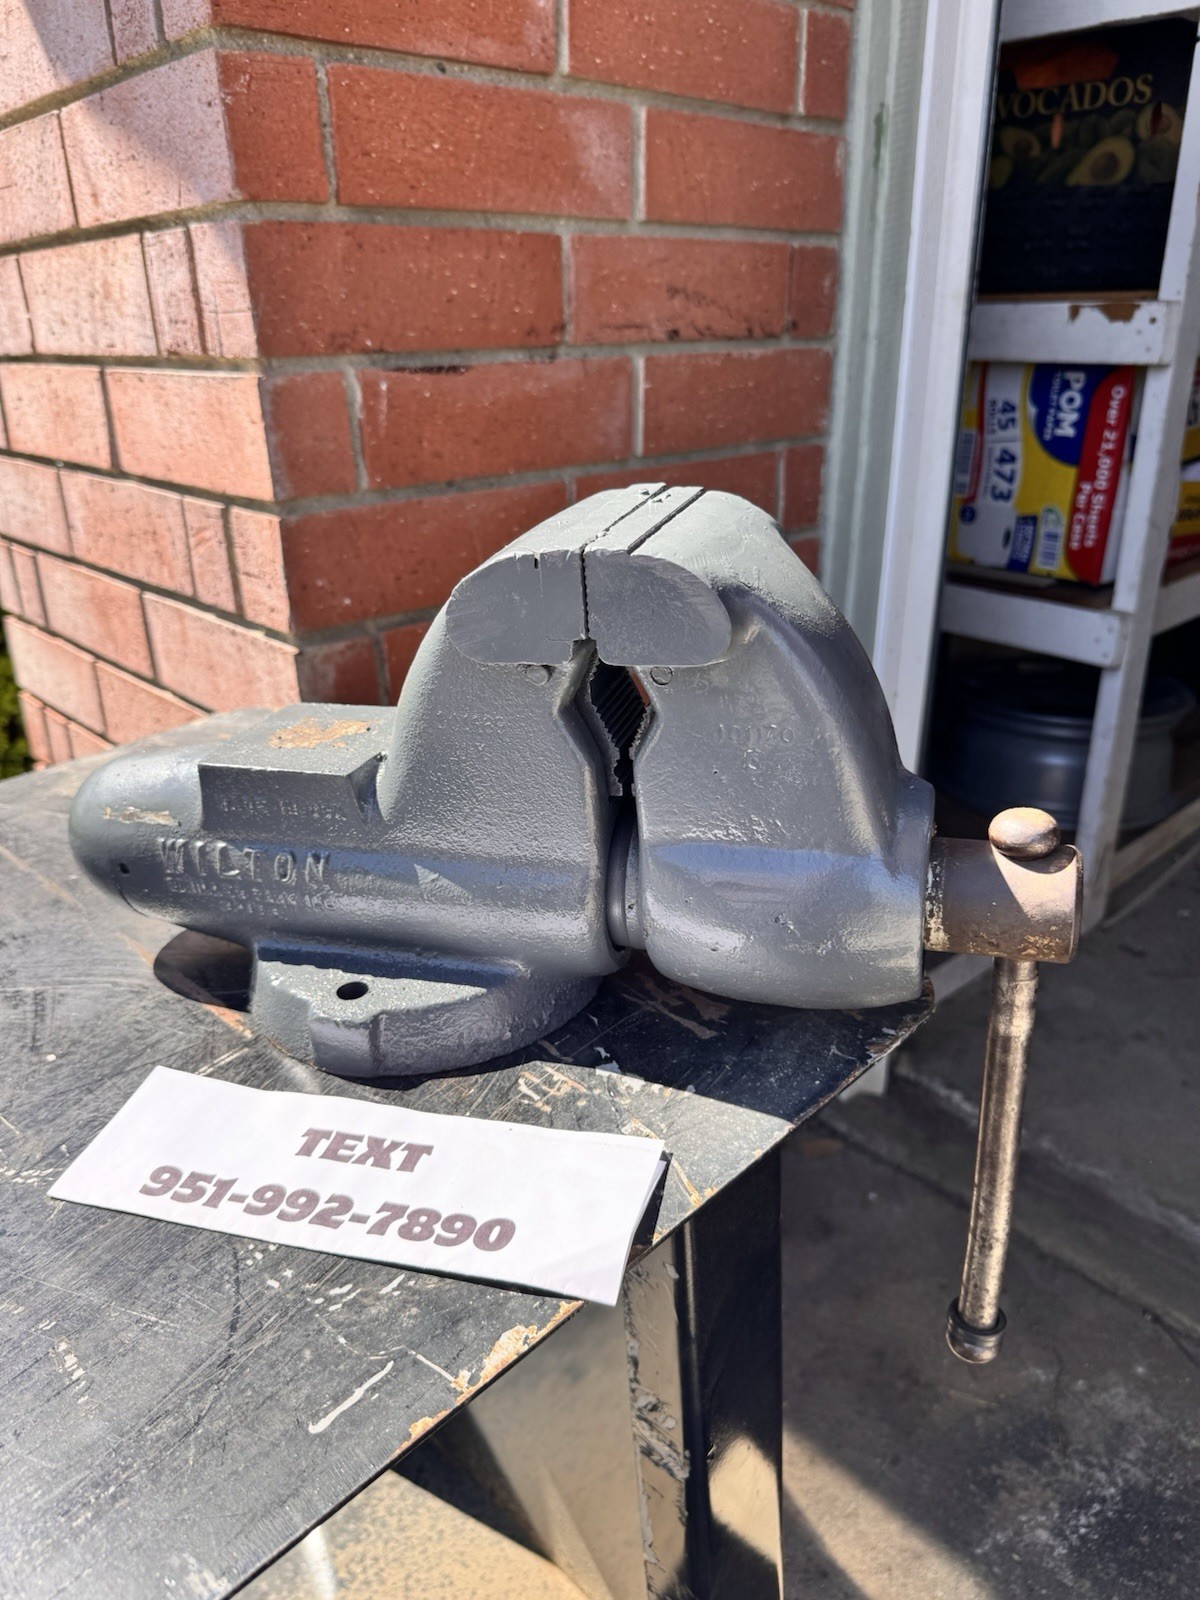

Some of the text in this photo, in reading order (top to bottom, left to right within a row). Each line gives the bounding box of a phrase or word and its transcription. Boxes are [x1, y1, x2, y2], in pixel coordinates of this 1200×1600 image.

[999, 75, 1153, 119] VOCADOS
[997, 400, 1017, 431] 45
[1054, 371, 1086, 438] POM
[1106, 384, 1127, 425] Over
[991, 448, 1018, 502] 473
[1094, 430, 1118, 489] 21,000
[1075, 482, 1092, 510] Per
[155, 837, 331, 885] WILTON
[295, 1127, 434, 1173] TEXT
[138, 1164, 516, 1253] 951-992-7890
